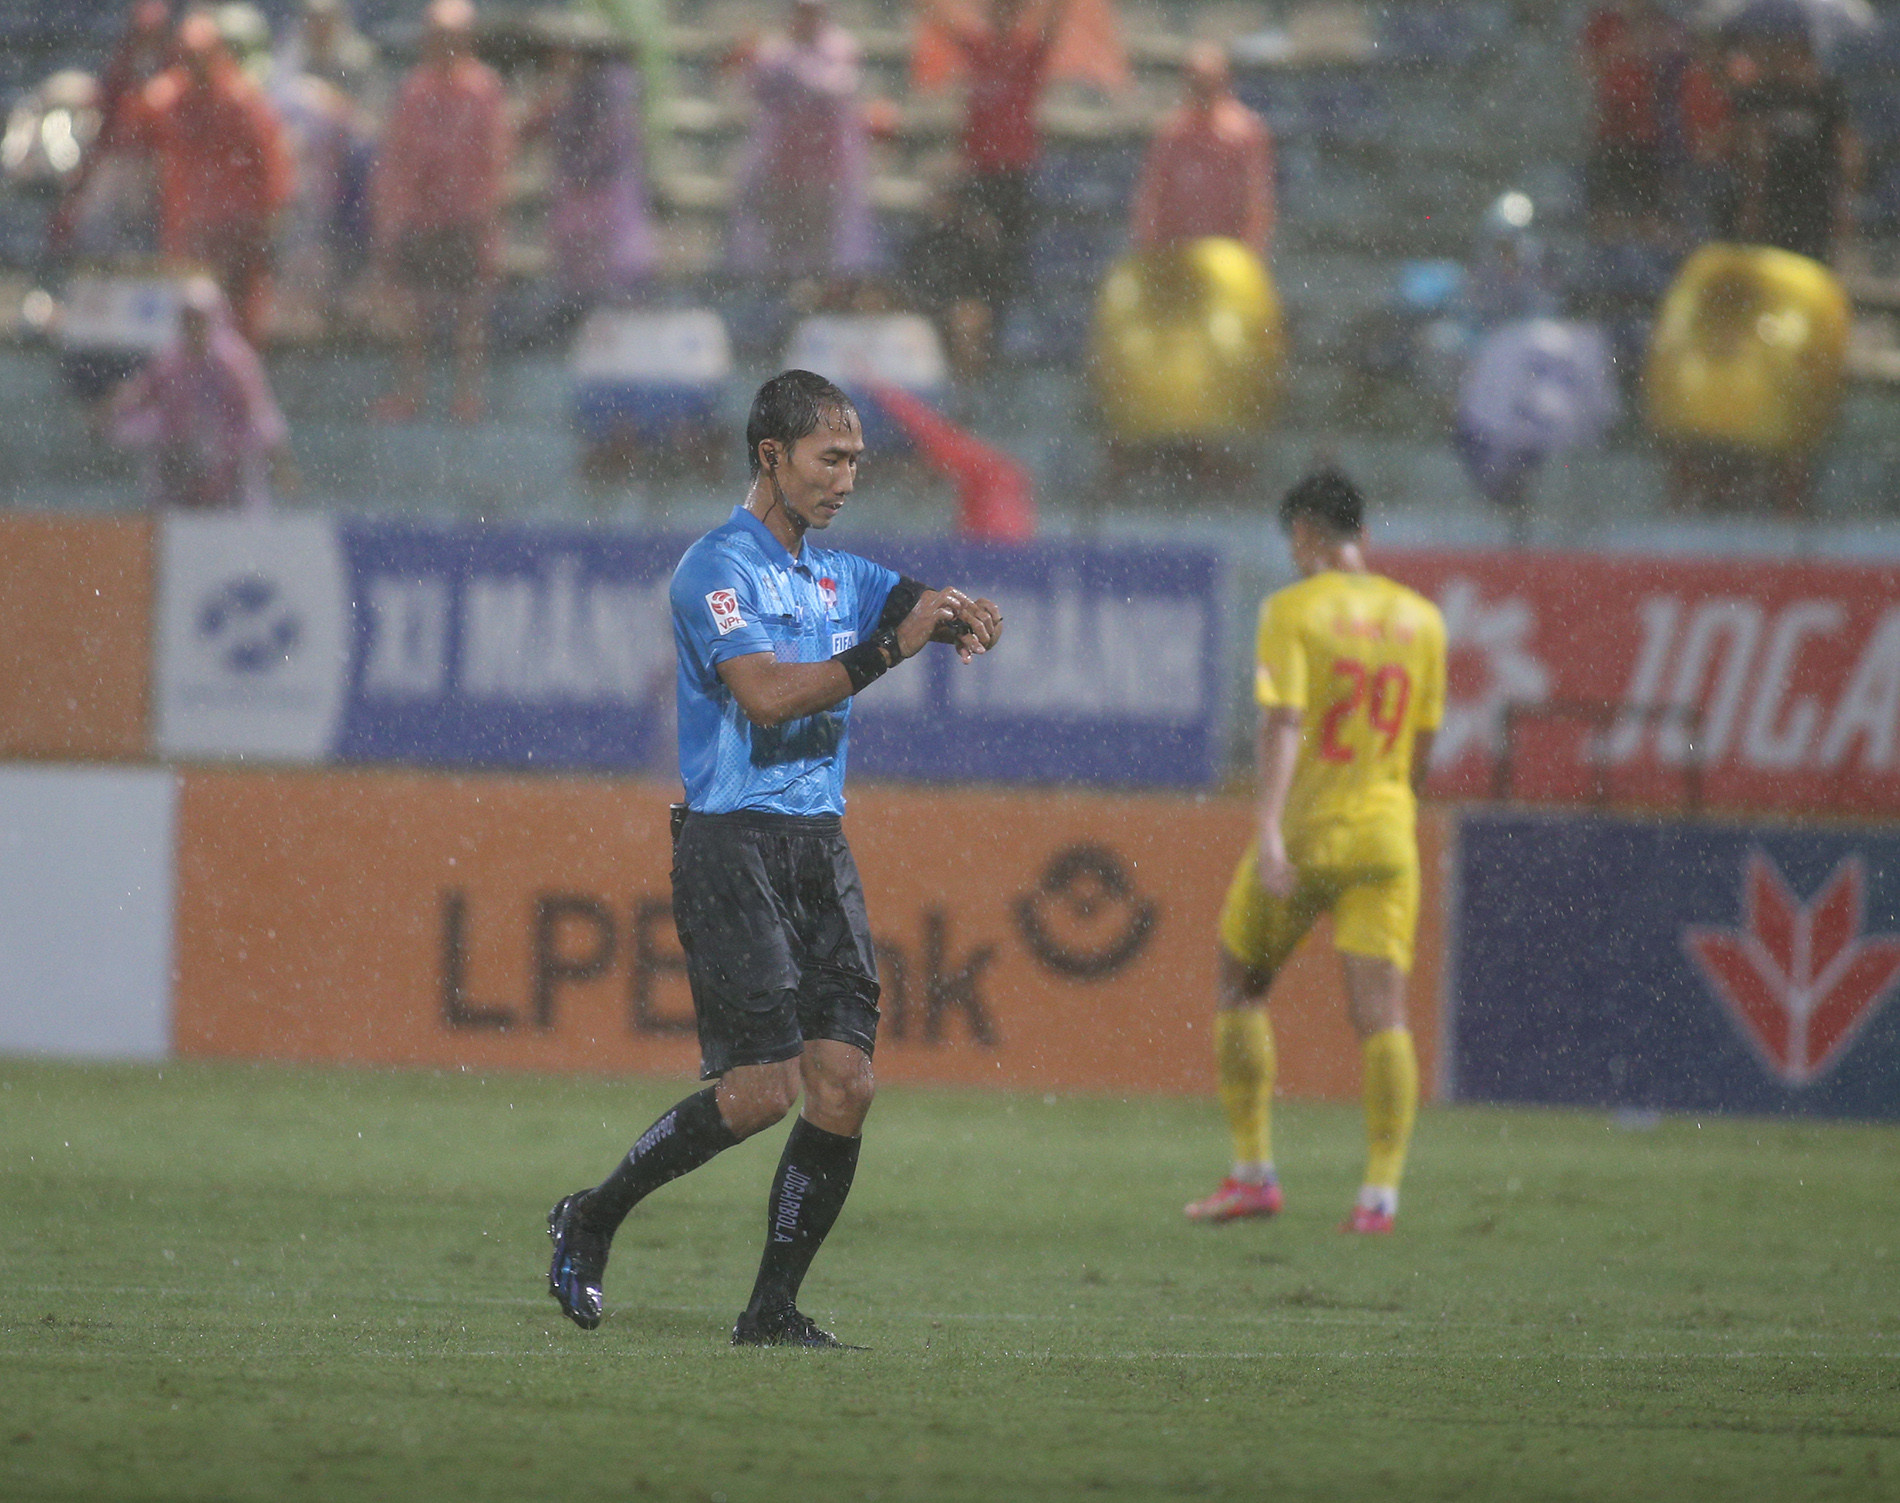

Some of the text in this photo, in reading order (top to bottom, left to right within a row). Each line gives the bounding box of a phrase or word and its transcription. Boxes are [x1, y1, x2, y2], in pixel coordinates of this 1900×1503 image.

[834, 635, 853, 652] FIFA
[1320, 660, 1412, 764] 29
[774, 1164, 811, 1242] JOGARBOLA
